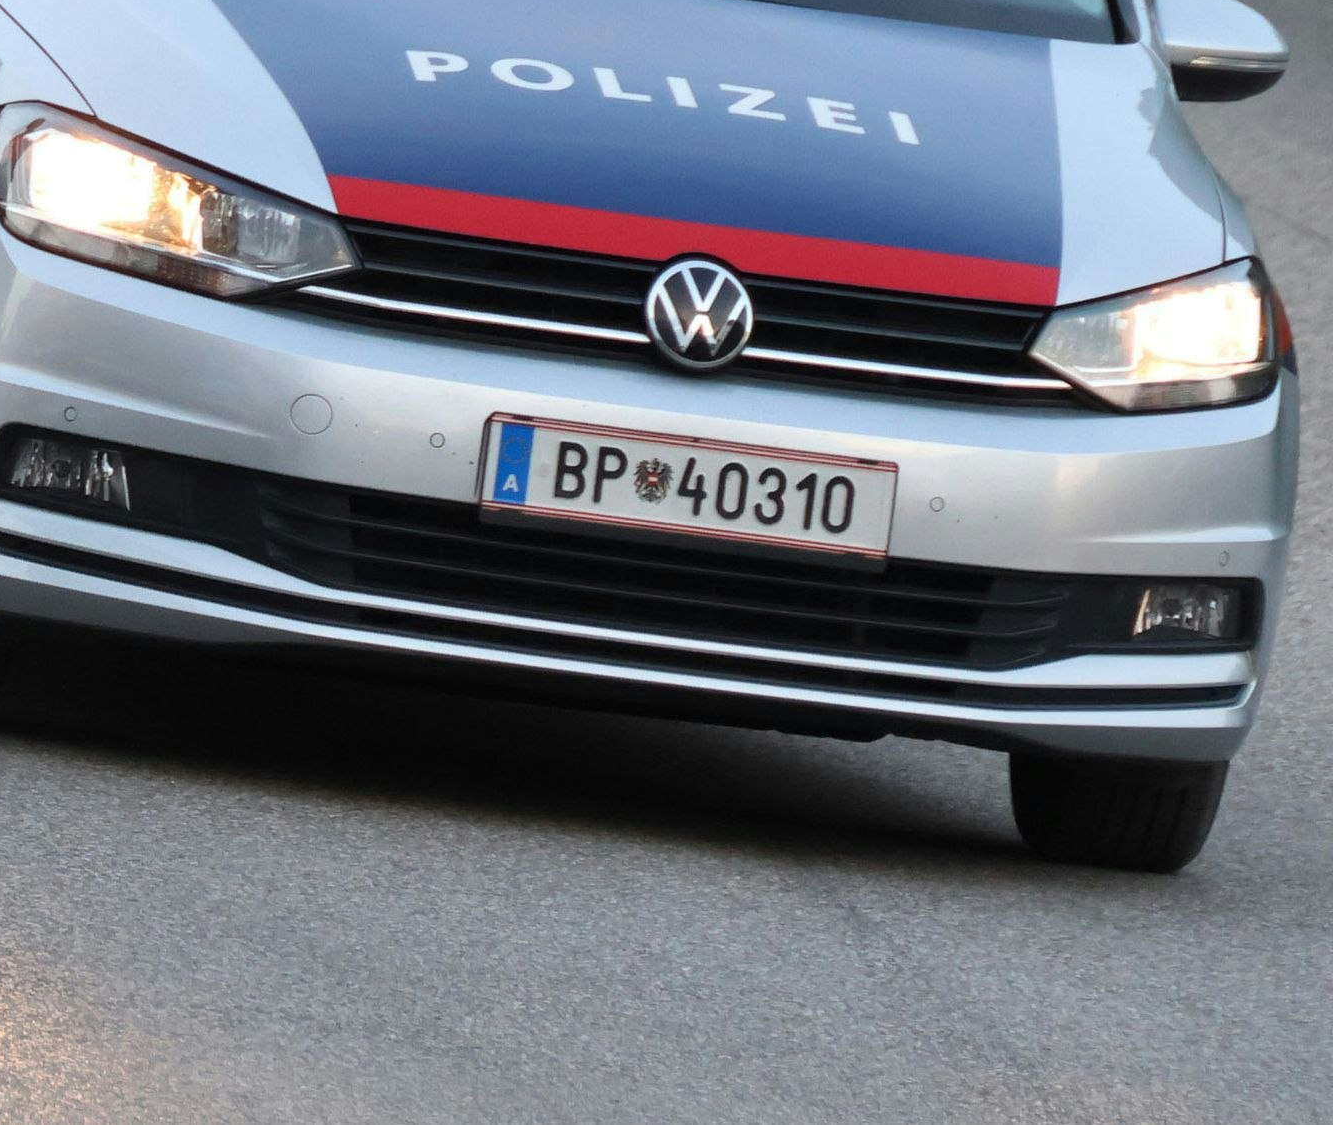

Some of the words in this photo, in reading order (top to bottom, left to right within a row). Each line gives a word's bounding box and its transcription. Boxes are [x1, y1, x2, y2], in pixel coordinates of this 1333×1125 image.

[405, 49, 921, 145] POLIZEI
[647, 260, 753, 367] VW
[501, 473, 520, 493] A
[553, 440, 628, 504] BP
[677, 456, 856, 534] 40310
